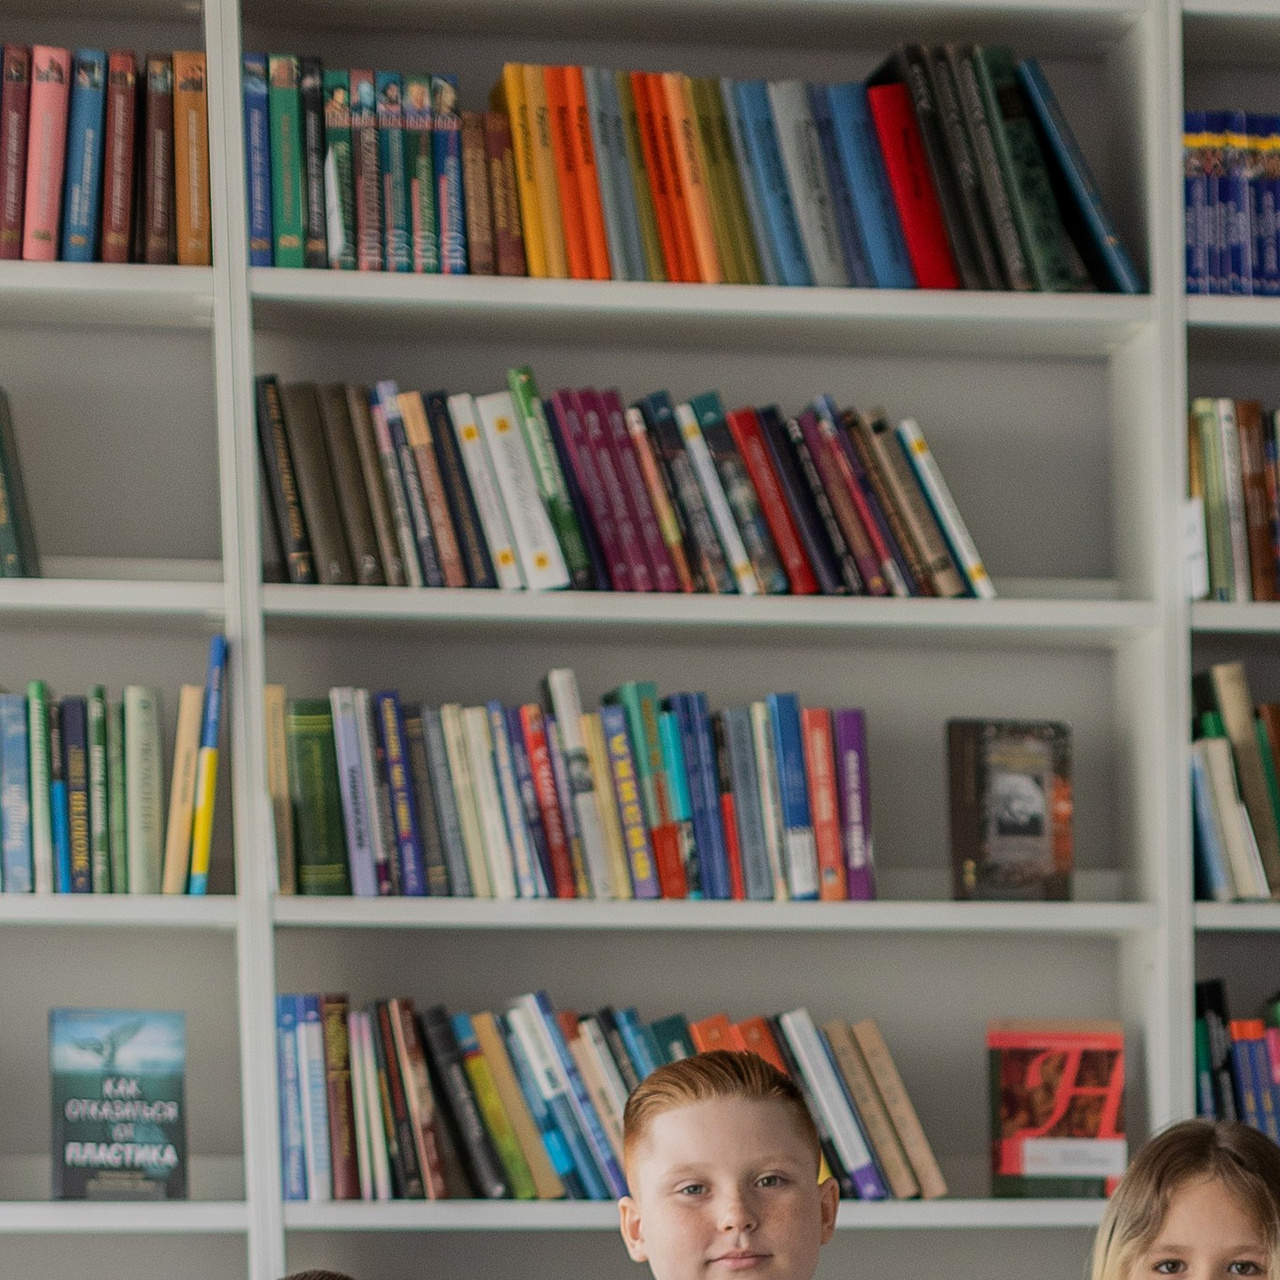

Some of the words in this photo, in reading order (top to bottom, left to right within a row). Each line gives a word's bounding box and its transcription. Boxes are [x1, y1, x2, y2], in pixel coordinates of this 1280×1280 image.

[71, 791, 90, 872] ЭКОЛОГИЯ
[103, 1078, 141, 1097] КАК
[65, 1099, 179, 1122] ОТКАЗАТЬСЯ
[111, 1123, 135, 1142] ОТ
[65, 1142, 179, 1167] ПЛАСТИКА
